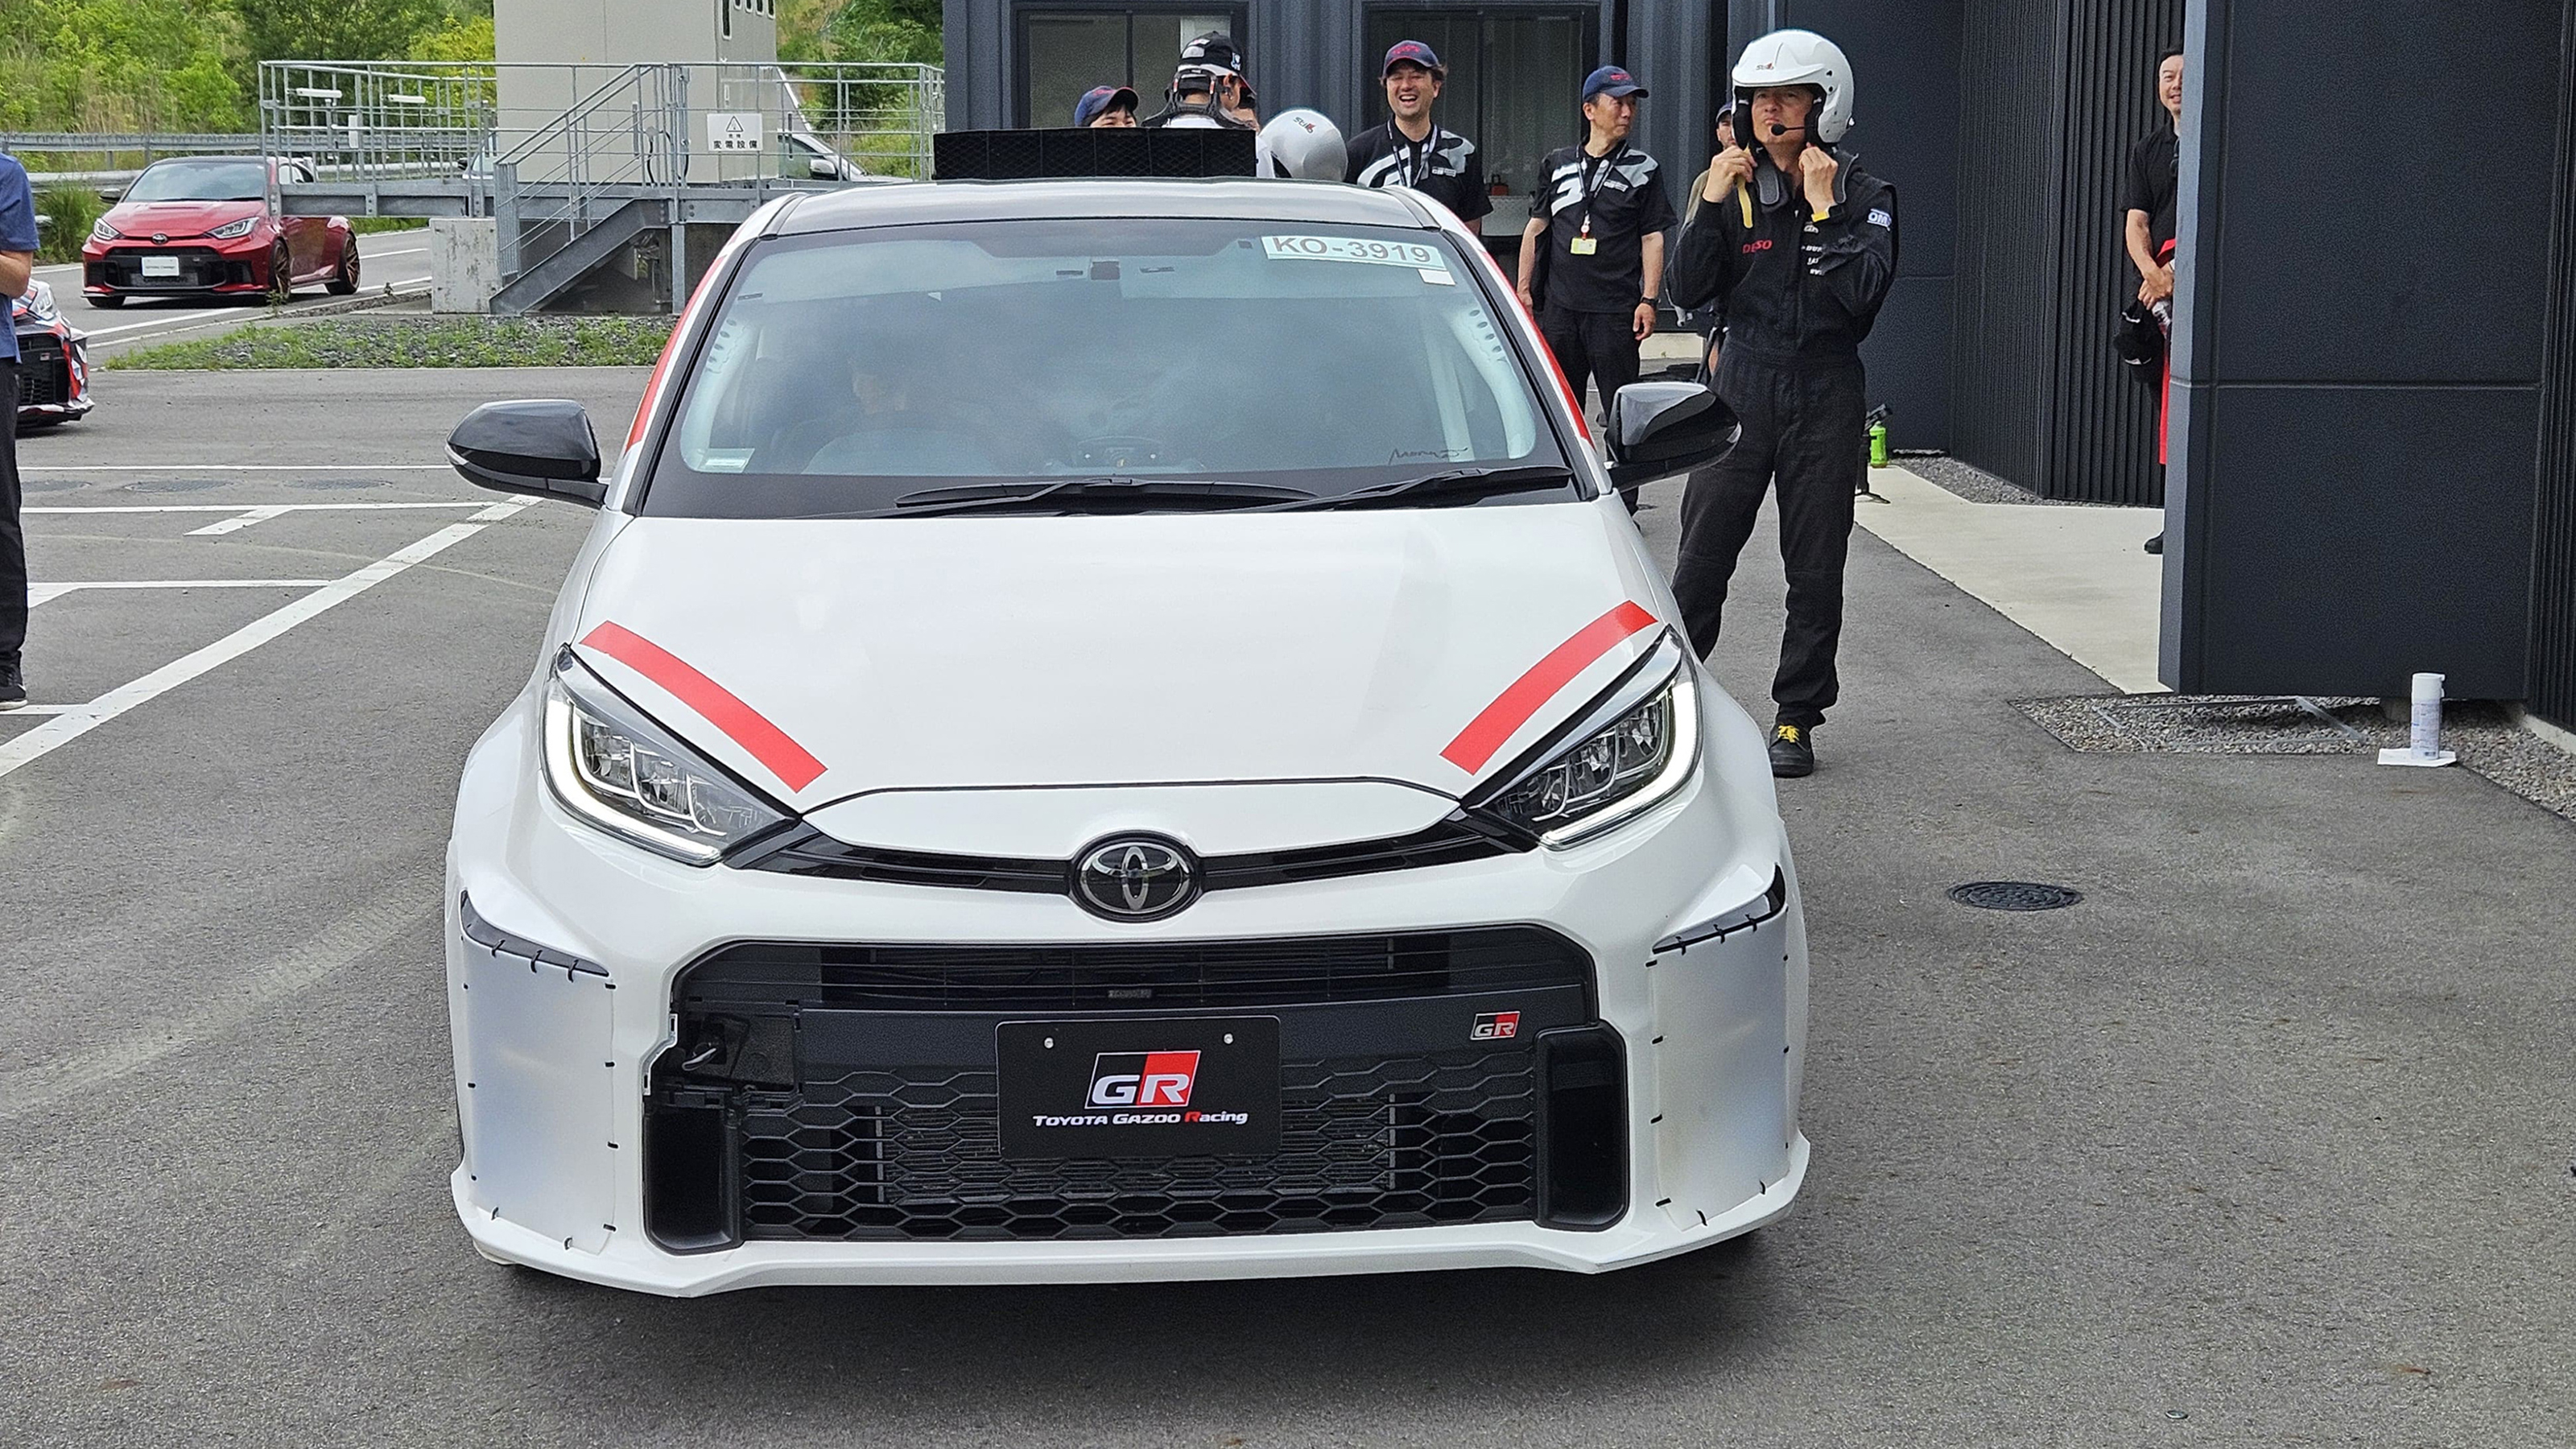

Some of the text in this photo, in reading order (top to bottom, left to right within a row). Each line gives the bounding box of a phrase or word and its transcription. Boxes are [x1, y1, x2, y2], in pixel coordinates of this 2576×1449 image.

[1272, 237, 1431, 263] KO-3919
[1742, 239, 1773, 254] DESO
[1473, 1022, 1515, 1038] GR
[1091, 1073, 1191, 1104] GR
[1033, 1110, 1249, 1127] TOYOTA GAZOO Racing
